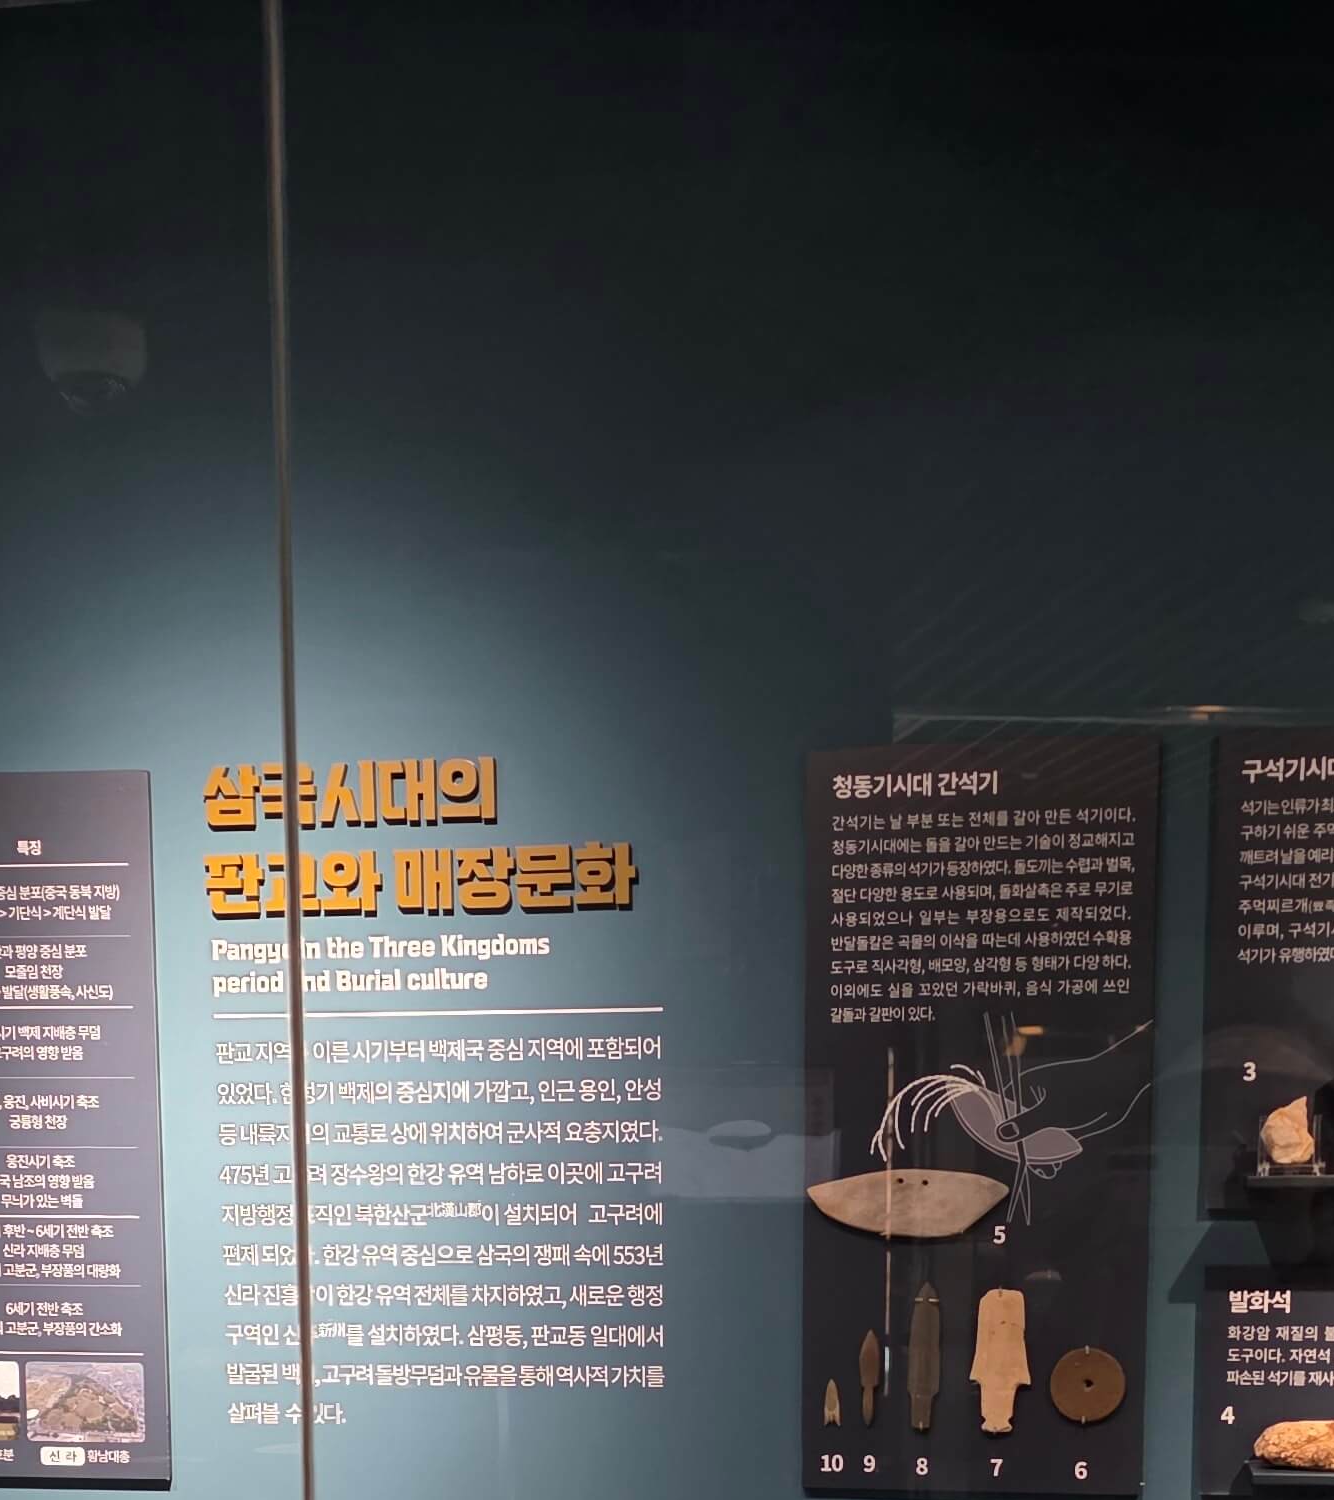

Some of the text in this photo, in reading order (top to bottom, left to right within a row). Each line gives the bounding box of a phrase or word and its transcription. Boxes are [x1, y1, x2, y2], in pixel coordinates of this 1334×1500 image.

[203, 758, 495, 826] 삼국시대의
[833, 771, 997, 798] 청동기시대 간석기
[833, 815, 885, 831] 간석기는
[907, 814, 932, 828] 부분
[938, 813, 963, 827] 또는
[969, 811, 1007, 827] 전체를
[1014, 810, 1040, 826] 갈아
[1045, 809, 1071, 824] 만든
[1076, 807, 1135, 823] 석기이다.
[17, 840, 41, 855] 특징
[205, 843, 636, 916] 판교와 매장문화
[327, 937, 364, 958] the
[368, 936, 435, 958] Three
[440, 934, 549, 960] Kingdoms
[1238, 948, 1276, 964] 석기가
[213, 968, 487, 997] period nd Burial culture
[216, 1042, 253, 1064] 판교
[313, 1040, 350, 1064] 이른
[352, 1040, 424, 1063] 시기부터
[429, 1039, 484, 1062] 백제국
[488, 1038, 523, 1061] 중심
[528, 1037, 583, 1061] 지역에
[587, 1036, 660, 1059] 포함되어
[1243, 1062, 1256, 1081] 3
[994, 1226, 1005, 1243] 5
[6, 1302, 34, 1316] 6세기
[37, 1302, 59, 1316] 전반
[1230, 1290, 1290, 1313] 발화석
[1228, 1326, 1270, 1341] 화강암
[1276, 1326, 1317, 1341] 재질의
[1227, 1348, 1285, 1363] 도구이다.
[1290, 1349, 1330, 1363] 자연석
[1227, 1370, 1264, 1385] 파손된
[1268, 1371, 1305, 1386] 석기를
[1221, 1407, 1235, 1424] 4
[821, 1455, 843, 1472] 10
[864, 1455, 875, 1472] 9
[916, 1458, 928, 1475] 8
[991, 1459, 1003, 1476] 7
[1075, 1462, 1087, 1479] 6
